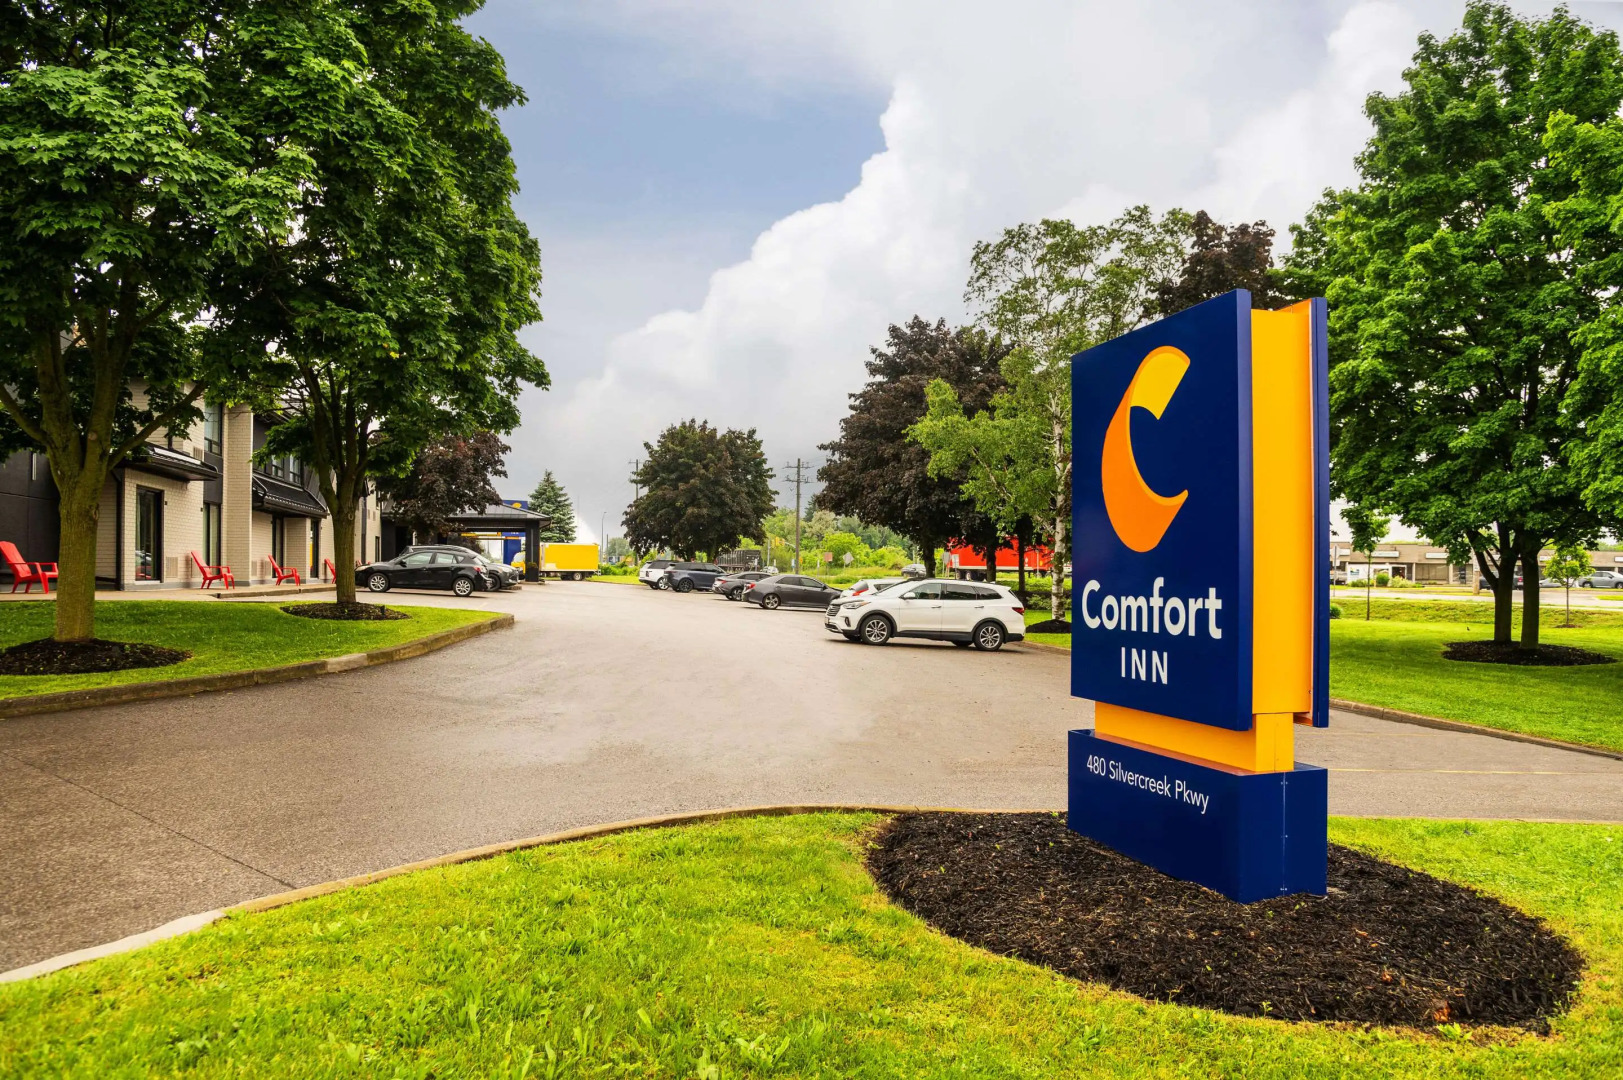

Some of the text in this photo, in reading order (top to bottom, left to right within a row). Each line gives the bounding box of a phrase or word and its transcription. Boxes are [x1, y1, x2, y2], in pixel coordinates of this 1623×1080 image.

[1081, 577, 1222, 639] Comfort
[1121, 646, 1168, 685] INN
[1086, 754, 1209, 814] 480 Silvercreek Pkwy
